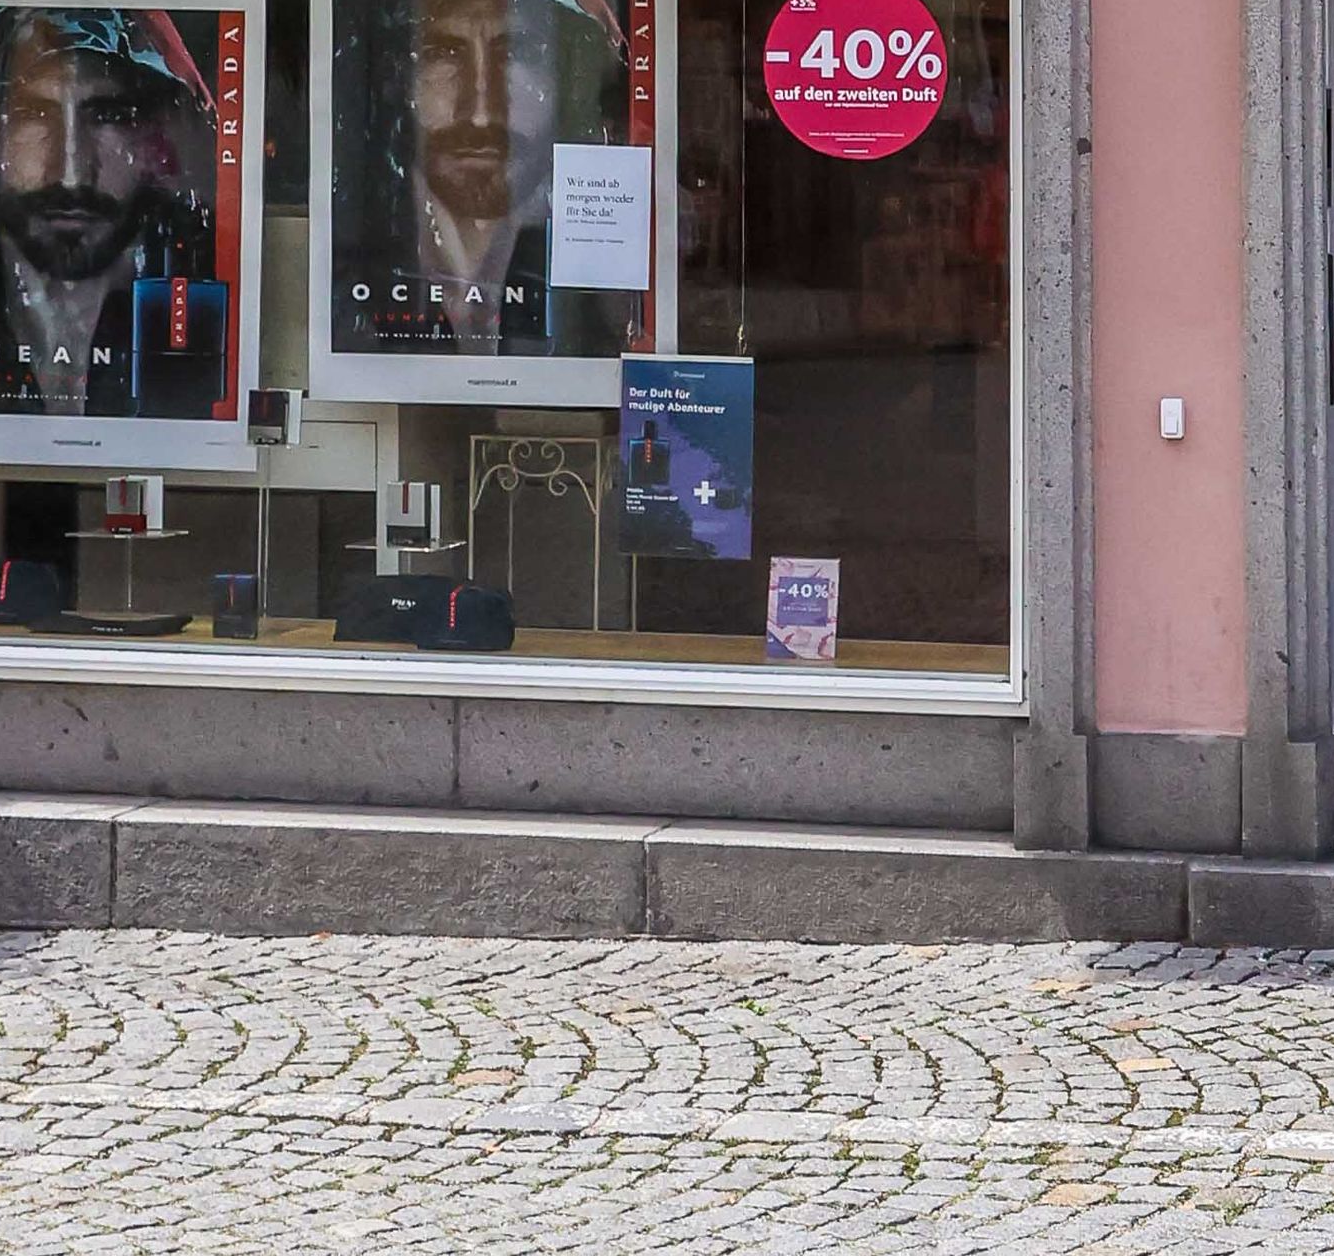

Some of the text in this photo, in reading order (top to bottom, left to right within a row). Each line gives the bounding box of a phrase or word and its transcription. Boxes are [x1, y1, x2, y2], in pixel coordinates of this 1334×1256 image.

[222, 26, 241, 164] PRADA
[774, 86, 938, 101] auf den zweiten Duft
[567, 176, 620, 188] Wir sind ab
[566, 192, 634, 204] morgen wieder
[582, 207, 597, 217] Sie
[599, 207, 614, 217] da!
[352, 284, 524, 303] OCEAN
[629, 387, 690, 399] Der Duft für
[629, 402, 726, 414] mutige Abenteurer
[778, 583, 829, 598] -40%
